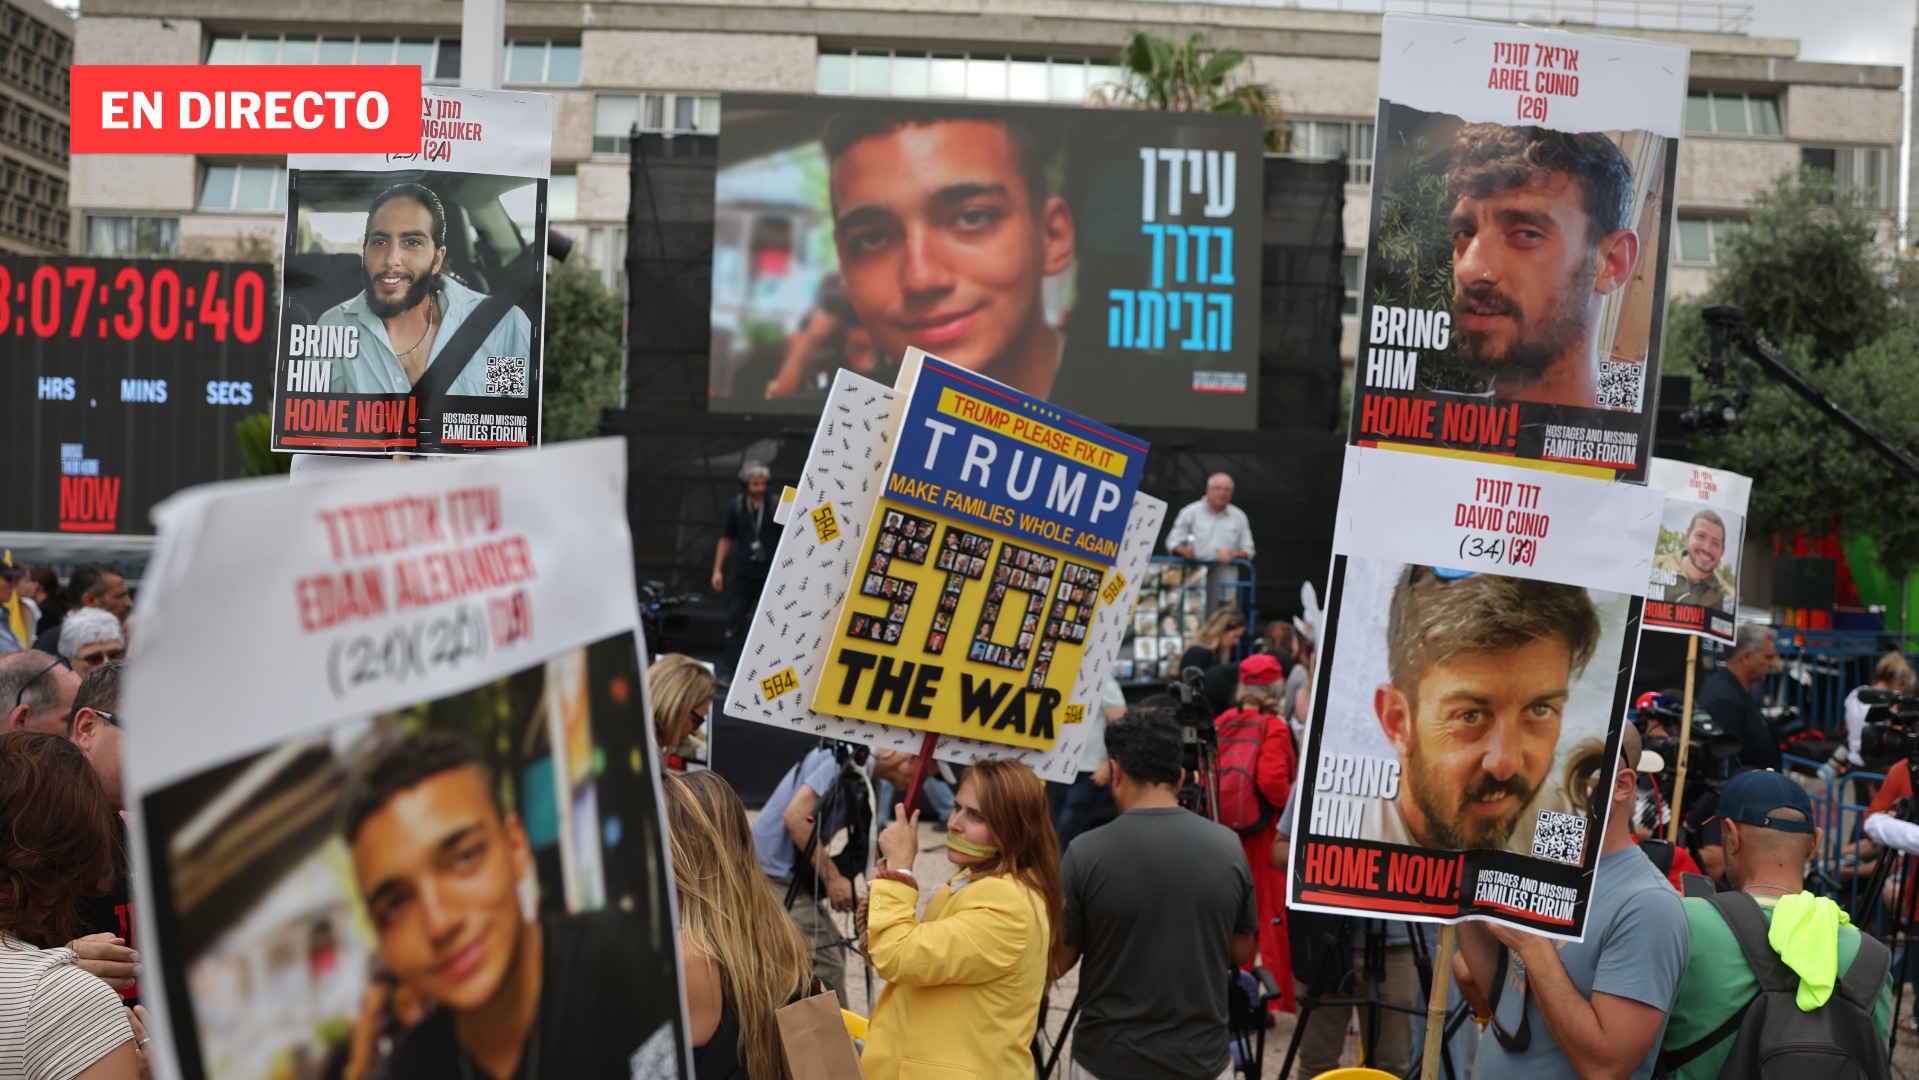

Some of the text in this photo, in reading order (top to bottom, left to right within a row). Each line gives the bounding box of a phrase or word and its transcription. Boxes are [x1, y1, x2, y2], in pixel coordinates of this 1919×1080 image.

[1494, 42, 1579, 71] אריאל קוניו
[1488, 67, 1579, 97] ARIEL CUNIO
[421, 97, 461, 119] מתן צ
[1517, 94, 1548, 122] (26)
[423, 140, 451, 162] (24)
[1139, 147, 1236, 222] עידן
[1141, 224, 1235, 289] בדרך
[1108, 289, 1233, 352] הביתה
[1369, 305, 1451, 350] BRING
[289, 324, 359, 358] BRING
[286, 360, 331, 393] HIM
[1365, 348, 1417, 391] HIM
[38, 377, 253, 405] HRS MINS SECS
[284, 396, 417, 434] HOME NOW!
[442, 424, 527, 442] FAMILIES FORUM
[443, 413, 527, 426] HOSTAGES AND MISSING
[954, 395, 1114, 468] TRUMP PLEASE FIX IT
[1361, 394, 1519, 447] HOME NOW!
[1543, 438, 1636, 465] FAMILIES FORUM
[1545, 424, 1638, 446] HOSTAGES AND MISSING
[924, 417, 1121, 524] TRUMP
[60, 475, 121, 520] NOW
[1476, 478, 1541, 509] דוד קוניו
[888, 473, 1120, 558] MAKE FAMILIES WHOLE AGAIN
[1455, 503, 1550, 538] DAVID CUNIO
[1459, 534, 1505, 564] (34)
[295, 535, 537, 634] EDAN ALEXANDER
[847, 507, 1104, 693] STOP
[1645, 601, 1705, 624] HOME NOW!
[763, 670, 796, 700] 584
[838, 648, 1061, 739] THE WAR
[1316, 751, 1401, 800] BRING
[1309, 794, 1364, 840] HIM
[1305, 842, 1464, 899] HOME NOW!
[1477, 869, 1578, 902] HOSTAGES AND MISSING
[1475, 883, 1575, 921] FAMILIES FORUM
